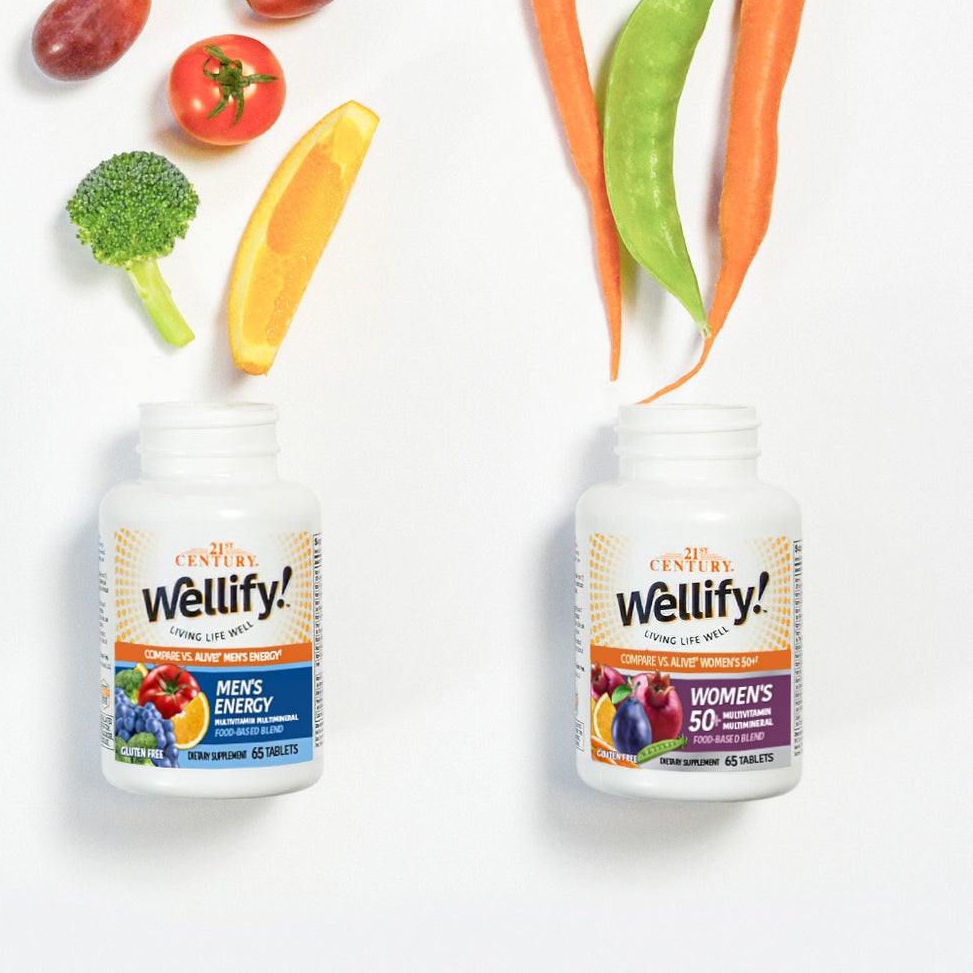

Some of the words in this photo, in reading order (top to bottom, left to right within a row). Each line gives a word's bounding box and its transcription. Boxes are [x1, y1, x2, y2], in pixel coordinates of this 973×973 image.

[142, 566, 292, 622] Wellify!
[617, 571, 769, 626] Wellify!
[170, 626, 202, 641] LIVING
[206, 632, 225, 642] LIFE
[229, 621, 253, 637] WELL
[644, 630, 676, 645] LIVING
[681, 635, 700, 645] LIFE
[703, 626, 729, 641] WELL
[144, 650, 181, 661] COMPARE
[182, 651, 193, 661] VS.
[223, 652, 248, 662] MEN'S
[621, 654, 656, 666] COMPARE
[658, 656, 669, 667] VS.
[700, 657, 740, 667] WOMEN'S
[216, 679, 262, 696] MEN'S
[691, 684, 773, 705] WOMEN'S
[214, 697, 274, 714] ENERGY
[723, 708, 771, 719] MULTIVITAMIN
[215, 718, 255, 726] MULTIVITAMIN
[257, 715, 299, 723] MULTIMINERAL
[723, 719, 774, 730] MULTIMINERAL
[215, 728, 259, 737] FOOD-BASED
[260, 726, 283, 734] BLEND
[694, 734, 739, 744] FOOD-BASED
[741, 732, 765, 742] BLEND
[121, 747, 145, 758] GLUTEN
[148, 748, 163, 759] FREE
[188, 751, 210, 760] DIETARY
[212, 751, 246, 760] SUPPLEMENT
[252, 747, 263, 759] 65
[266, 744, 298, 756] TABLETS
[597, 749, 622, 760] GLUTEN
[623, 752, 637, 763] FREE
[660, 756, 682, 765] DIETARY
[683, 758, 719, 766] SUPPLEMENT
[725, 755, 737, 766] 65
[739, 753, 774, 765] TABLETS
